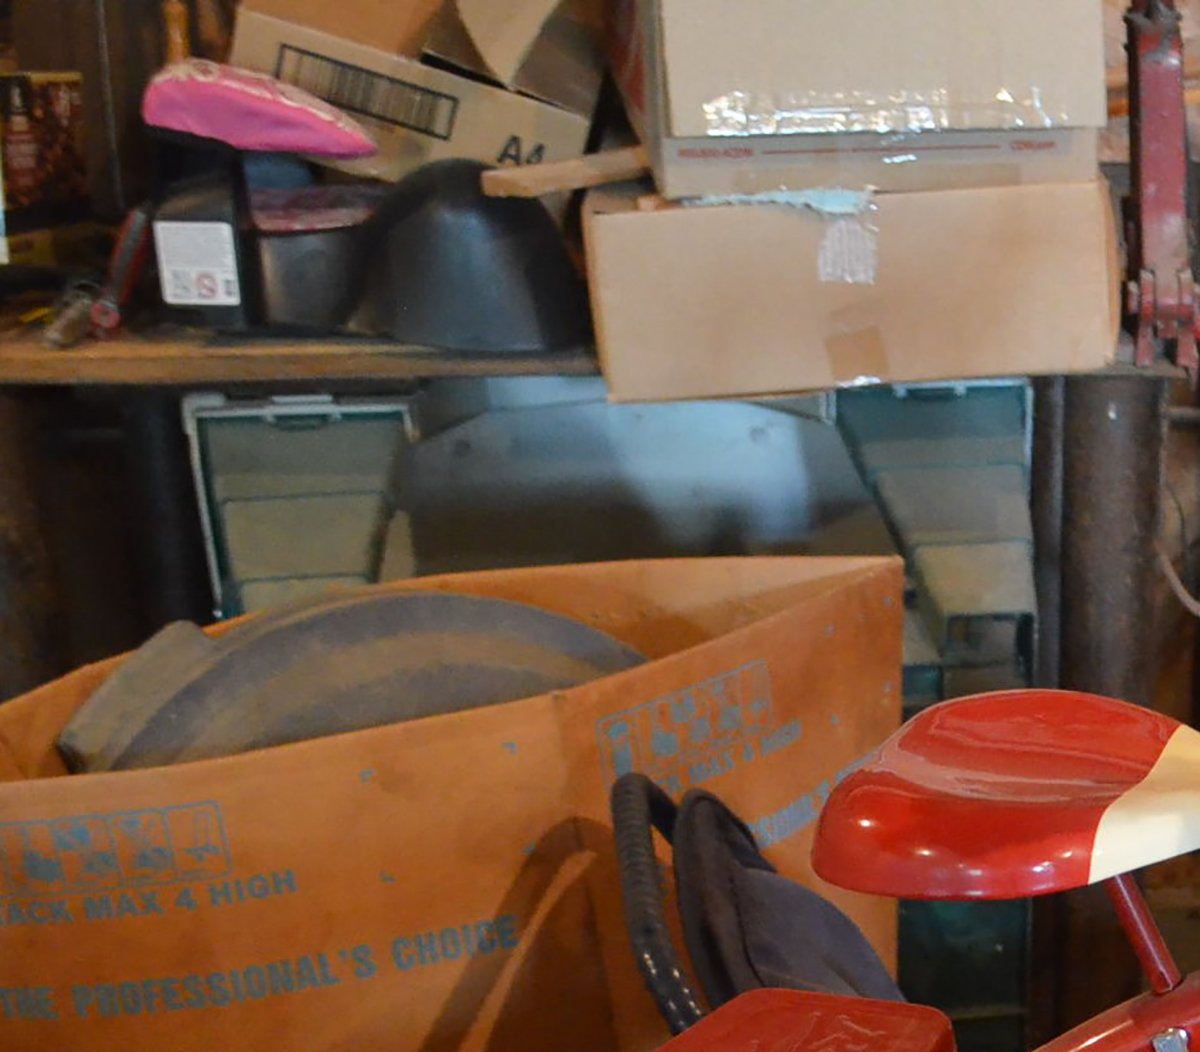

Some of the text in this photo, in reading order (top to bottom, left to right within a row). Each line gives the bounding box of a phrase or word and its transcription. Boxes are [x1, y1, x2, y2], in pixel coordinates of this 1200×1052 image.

[83, 891, 163, 922] MAX
[175, 888, 199, 912] 4
[208, 869, 298, 908] HIGH
[72, 943, 379, 1019] PROFESSIONAL'S
[391, 913, 522, 972] CHOICE
